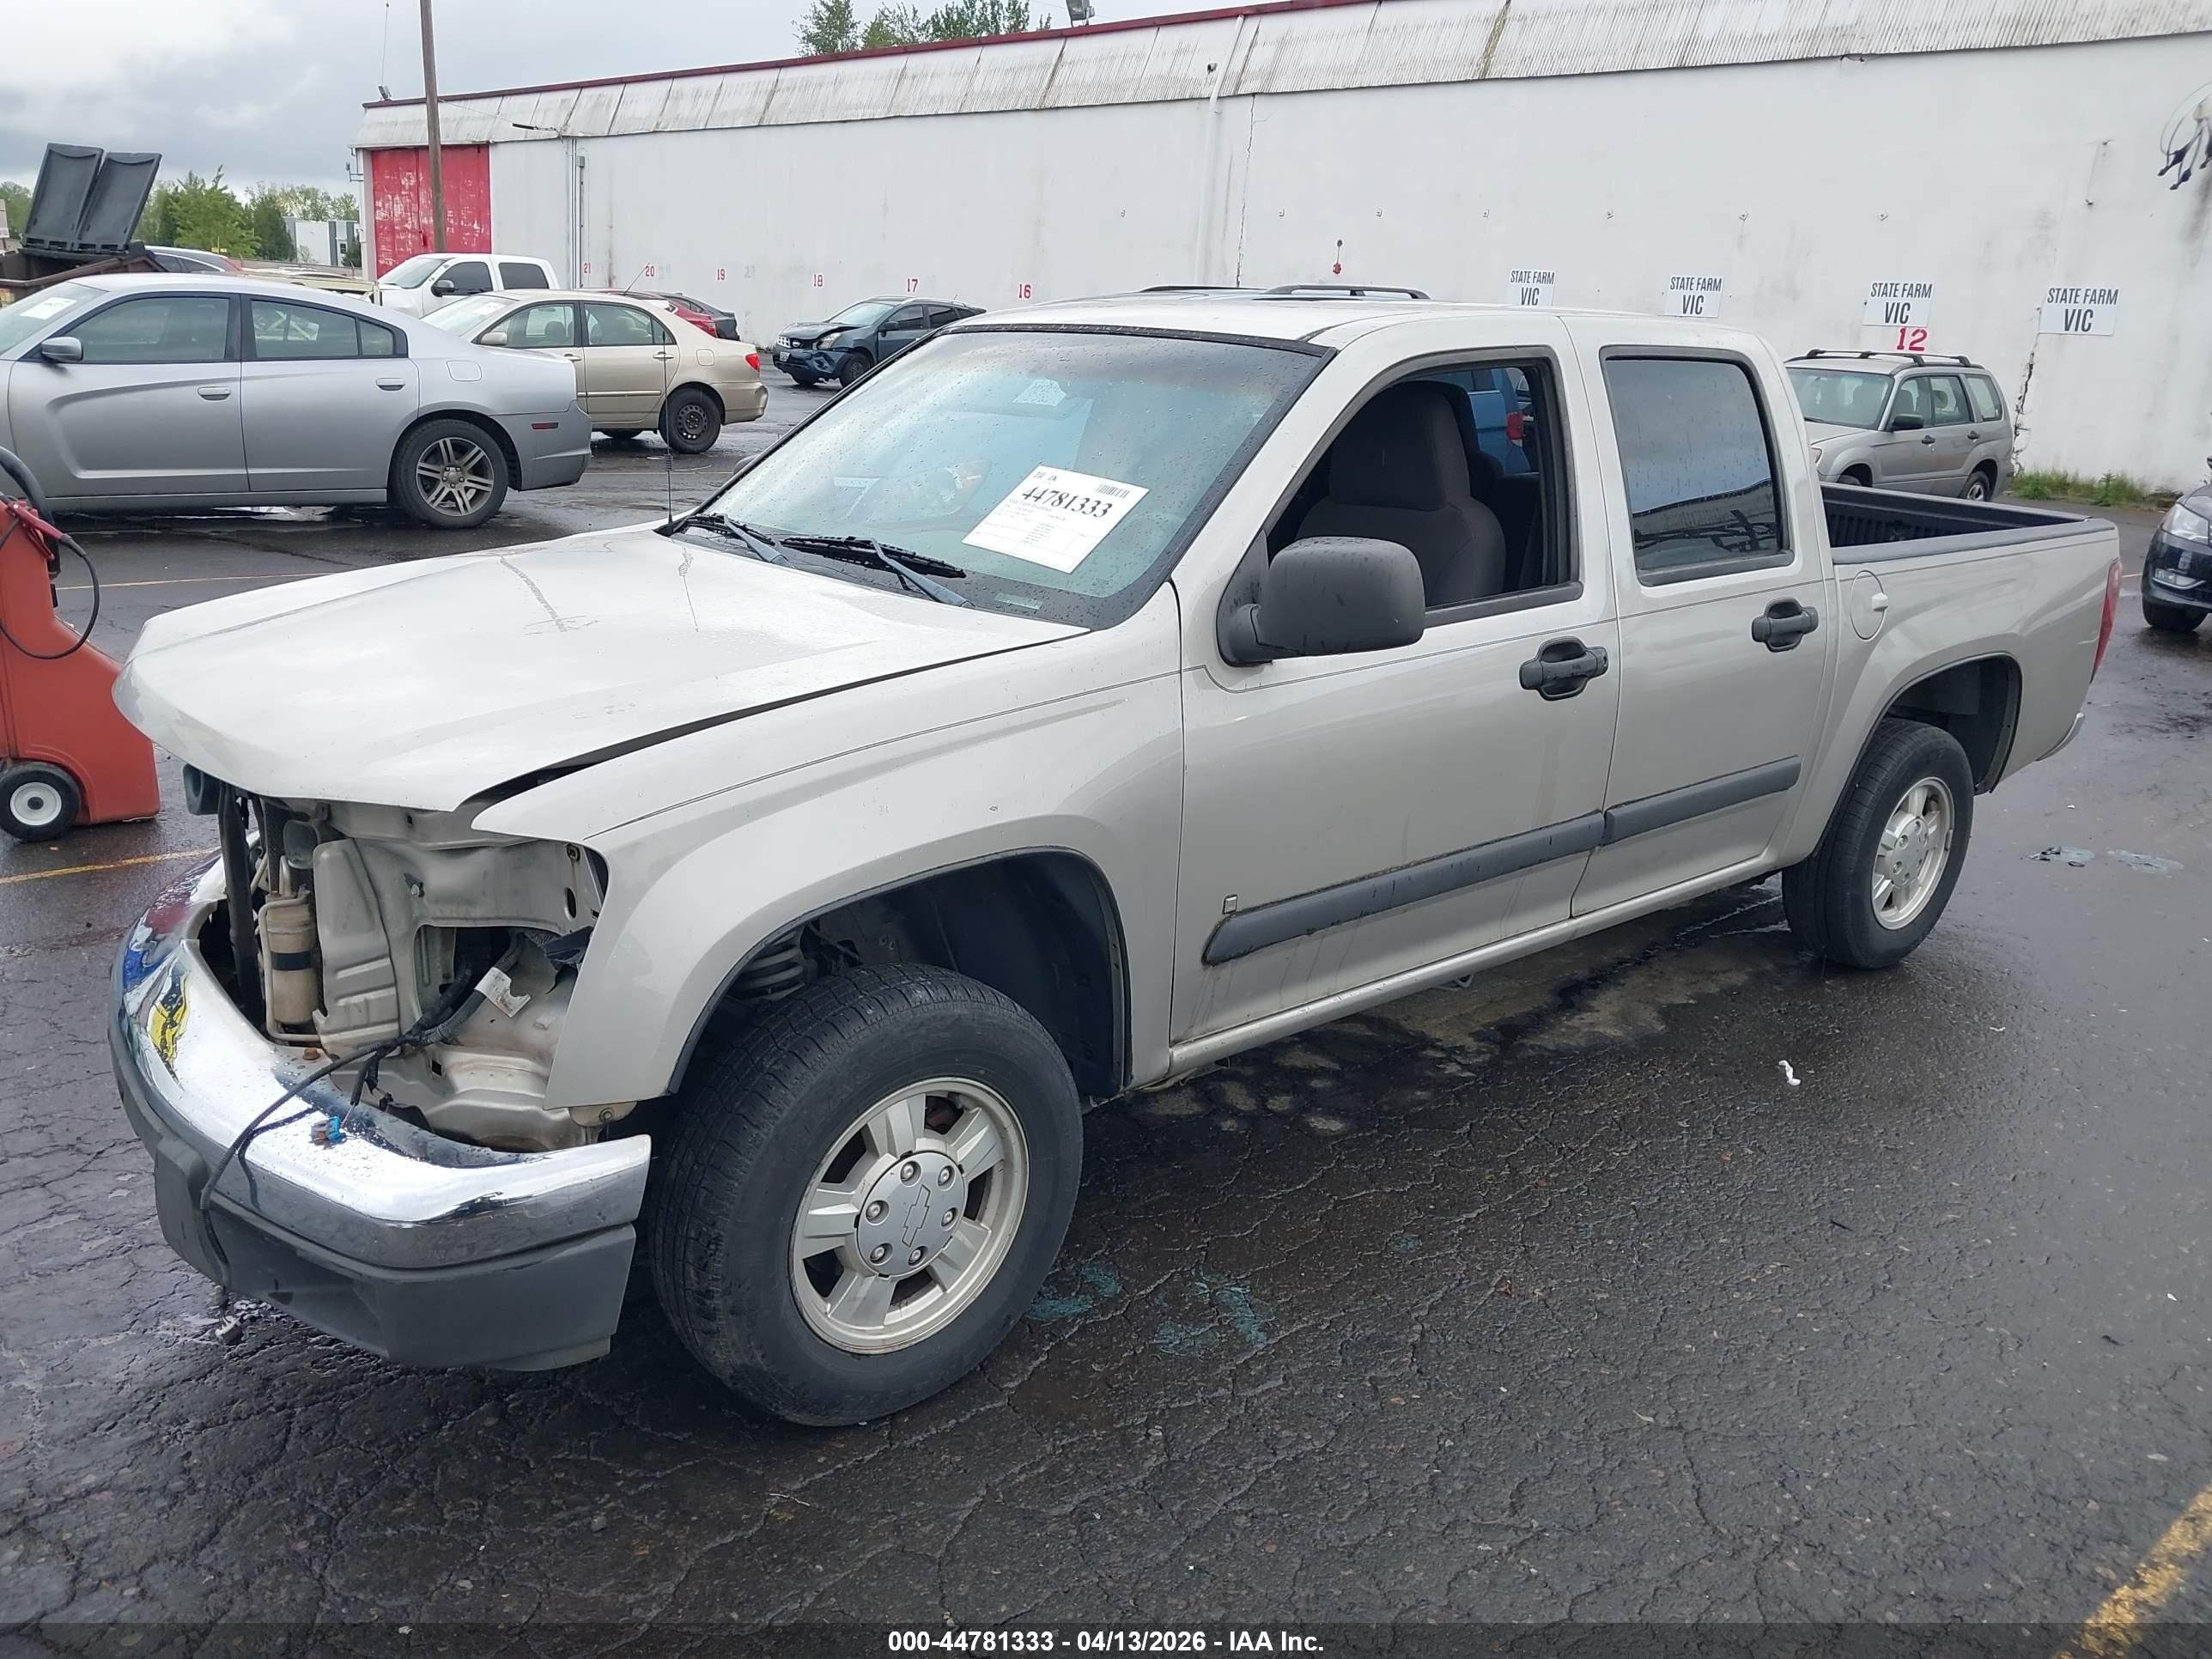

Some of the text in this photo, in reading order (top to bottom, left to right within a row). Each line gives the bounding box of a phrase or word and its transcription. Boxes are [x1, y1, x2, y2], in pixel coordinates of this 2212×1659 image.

[583, 263, 591, 274] 21
[645, 266, 655, 277] 20
[716, 268, 726, 281] 19
[813, 275, 823, 287] 18
[907, 278, 919, 292] 17
[1510, 270, 1555, 285] STATE FARM
[1670, 276, 1723, 292] STATE FARM
[1018, 284, 1031, 299] 16
[1521, 287, 1540, 306] VIC
[1870, 283, 1932, 299] STATE FARM
[2047, 288, 2119, 306] STATE FARM
[1682, 295, 1705, 315] VIC
[1884, 301, 1911, 324] VIC
[2064, 308, 2094, 332] VIC
[1896, 327, 1928, 351] 12
[1022, 486, 1113, 518] 44781333
